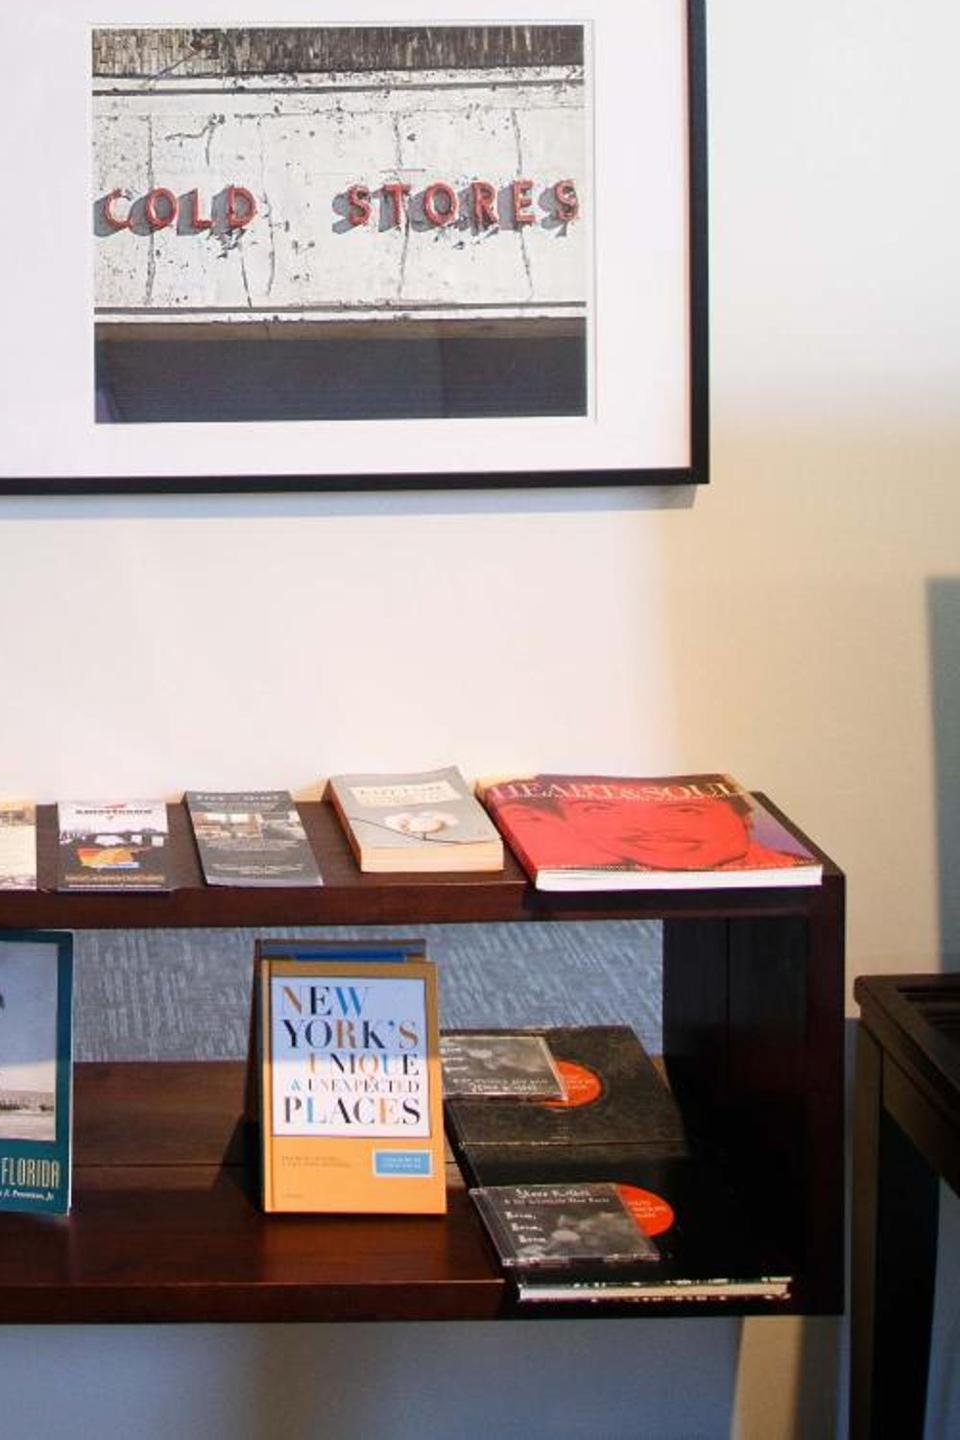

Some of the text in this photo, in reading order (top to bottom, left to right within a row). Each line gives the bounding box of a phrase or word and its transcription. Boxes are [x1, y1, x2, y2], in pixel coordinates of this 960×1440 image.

[98, 179, 580, 232] COLD STORES
[281, 986, 371, 1016] NEW
[281, 1019, 420, 1050] YORK'S
[307, 1053, 420, 1079] UNIQUE
[307, 1079, 420, 1093] UNEXPECTED
[283, 1097, 422, 1126] PLACES
[0, 1156, 61, 1190] FLORIDA
